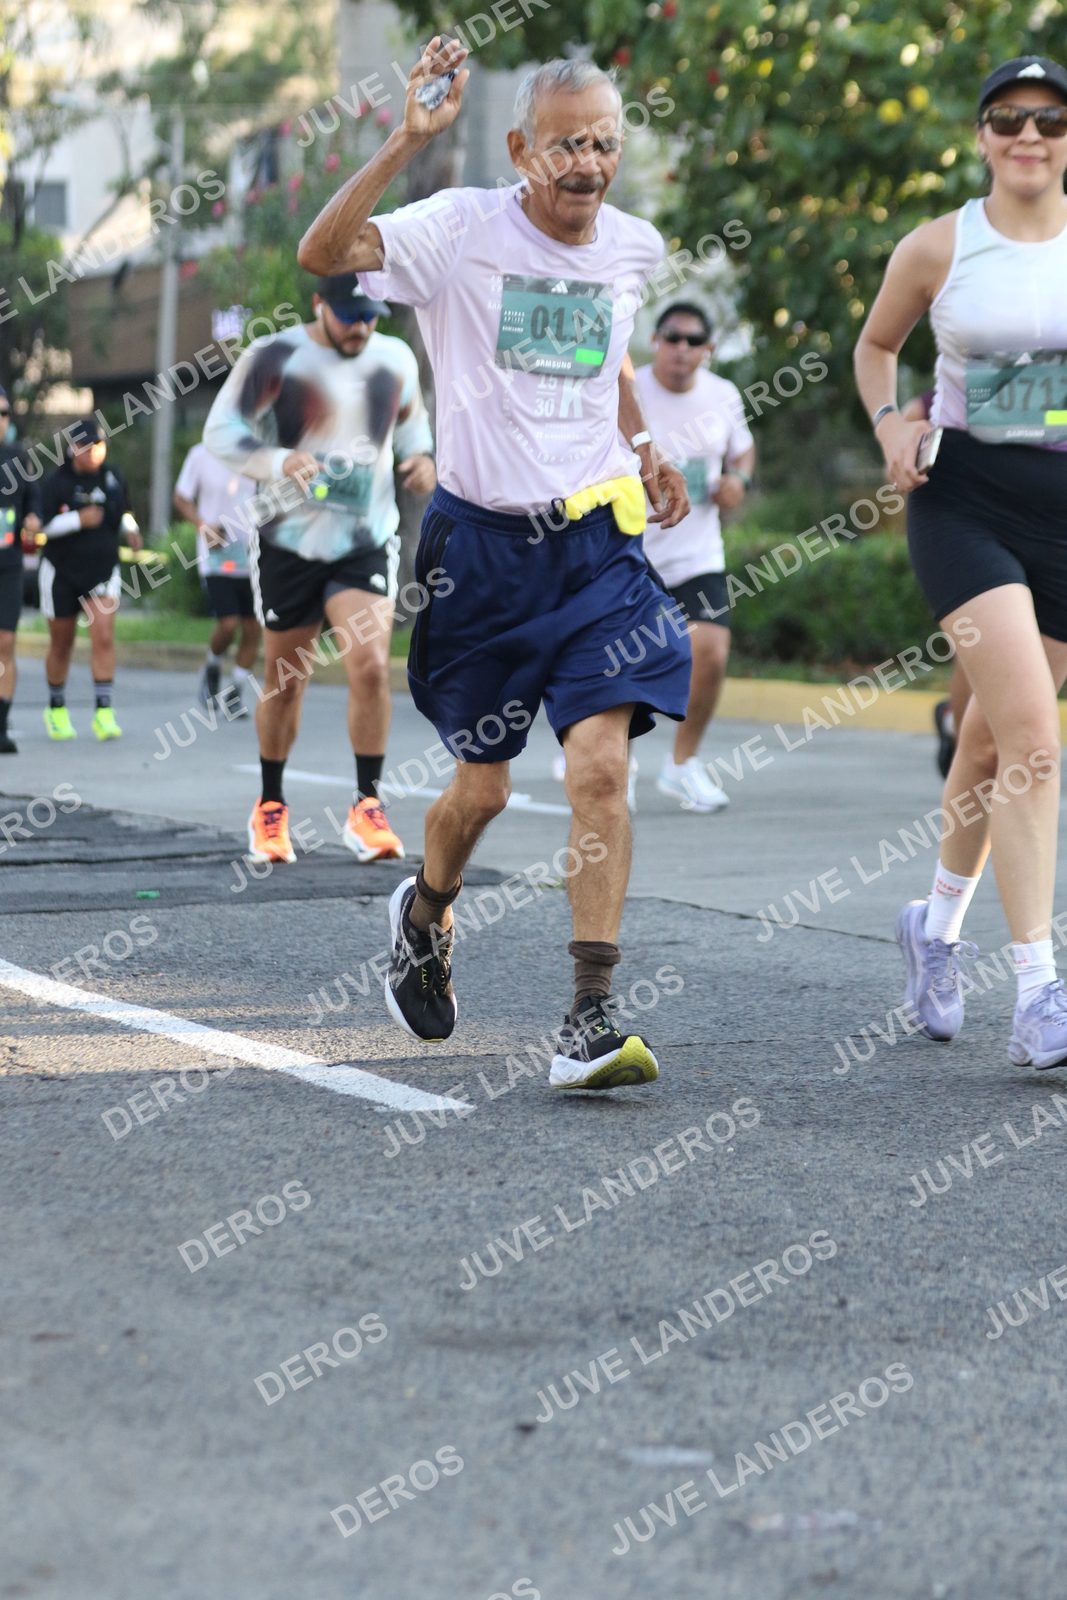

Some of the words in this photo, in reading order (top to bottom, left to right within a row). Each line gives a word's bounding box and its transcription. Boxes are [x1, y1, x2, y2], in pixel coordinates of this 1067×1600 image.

[535, 359, 572, 370] SAMSUNG
[996, 376, 1067, 412] 071
[534, 398, 555, 418] 30
